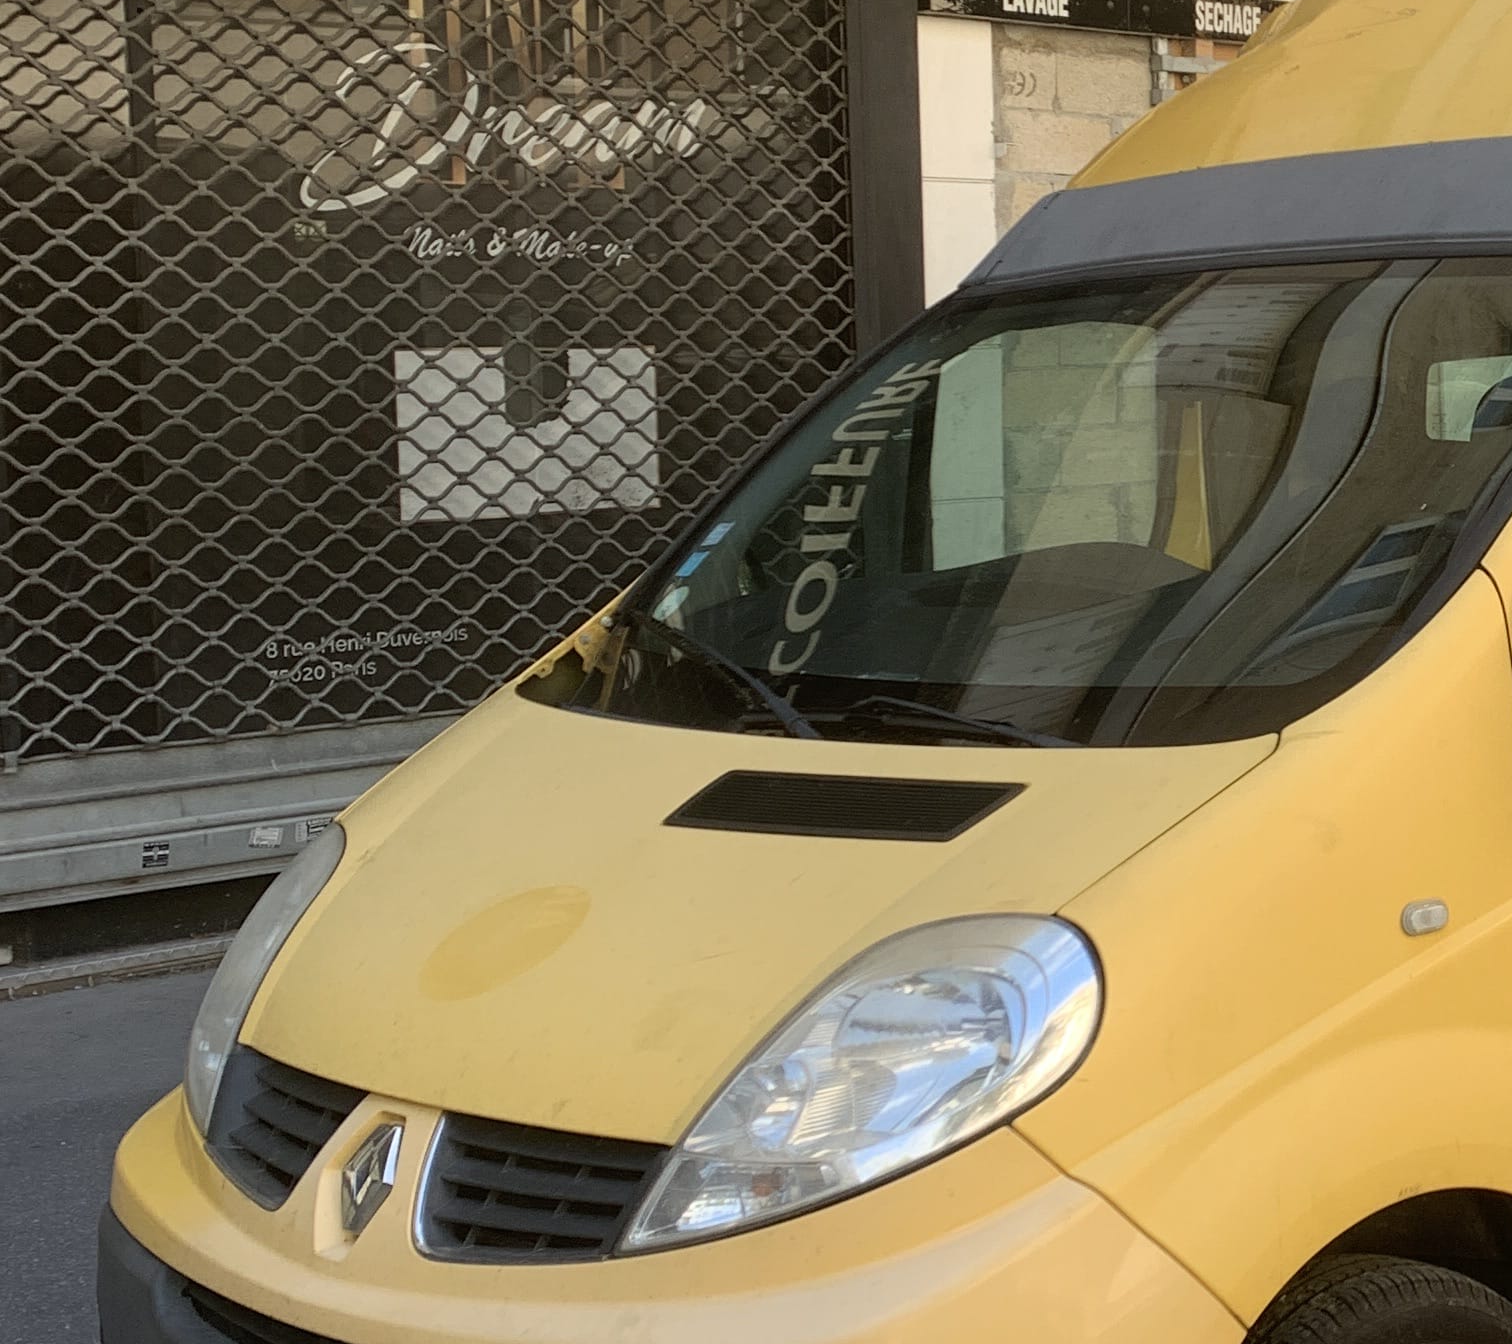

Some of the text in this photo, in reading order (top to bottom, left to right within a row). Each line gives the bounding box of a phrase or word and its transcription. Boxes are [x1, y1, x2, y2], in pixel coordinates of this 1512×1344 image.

[265, 641, 278, 659] 8
[283, 640, 316, 657] rue
[320, 631, 372, 654] Henri
